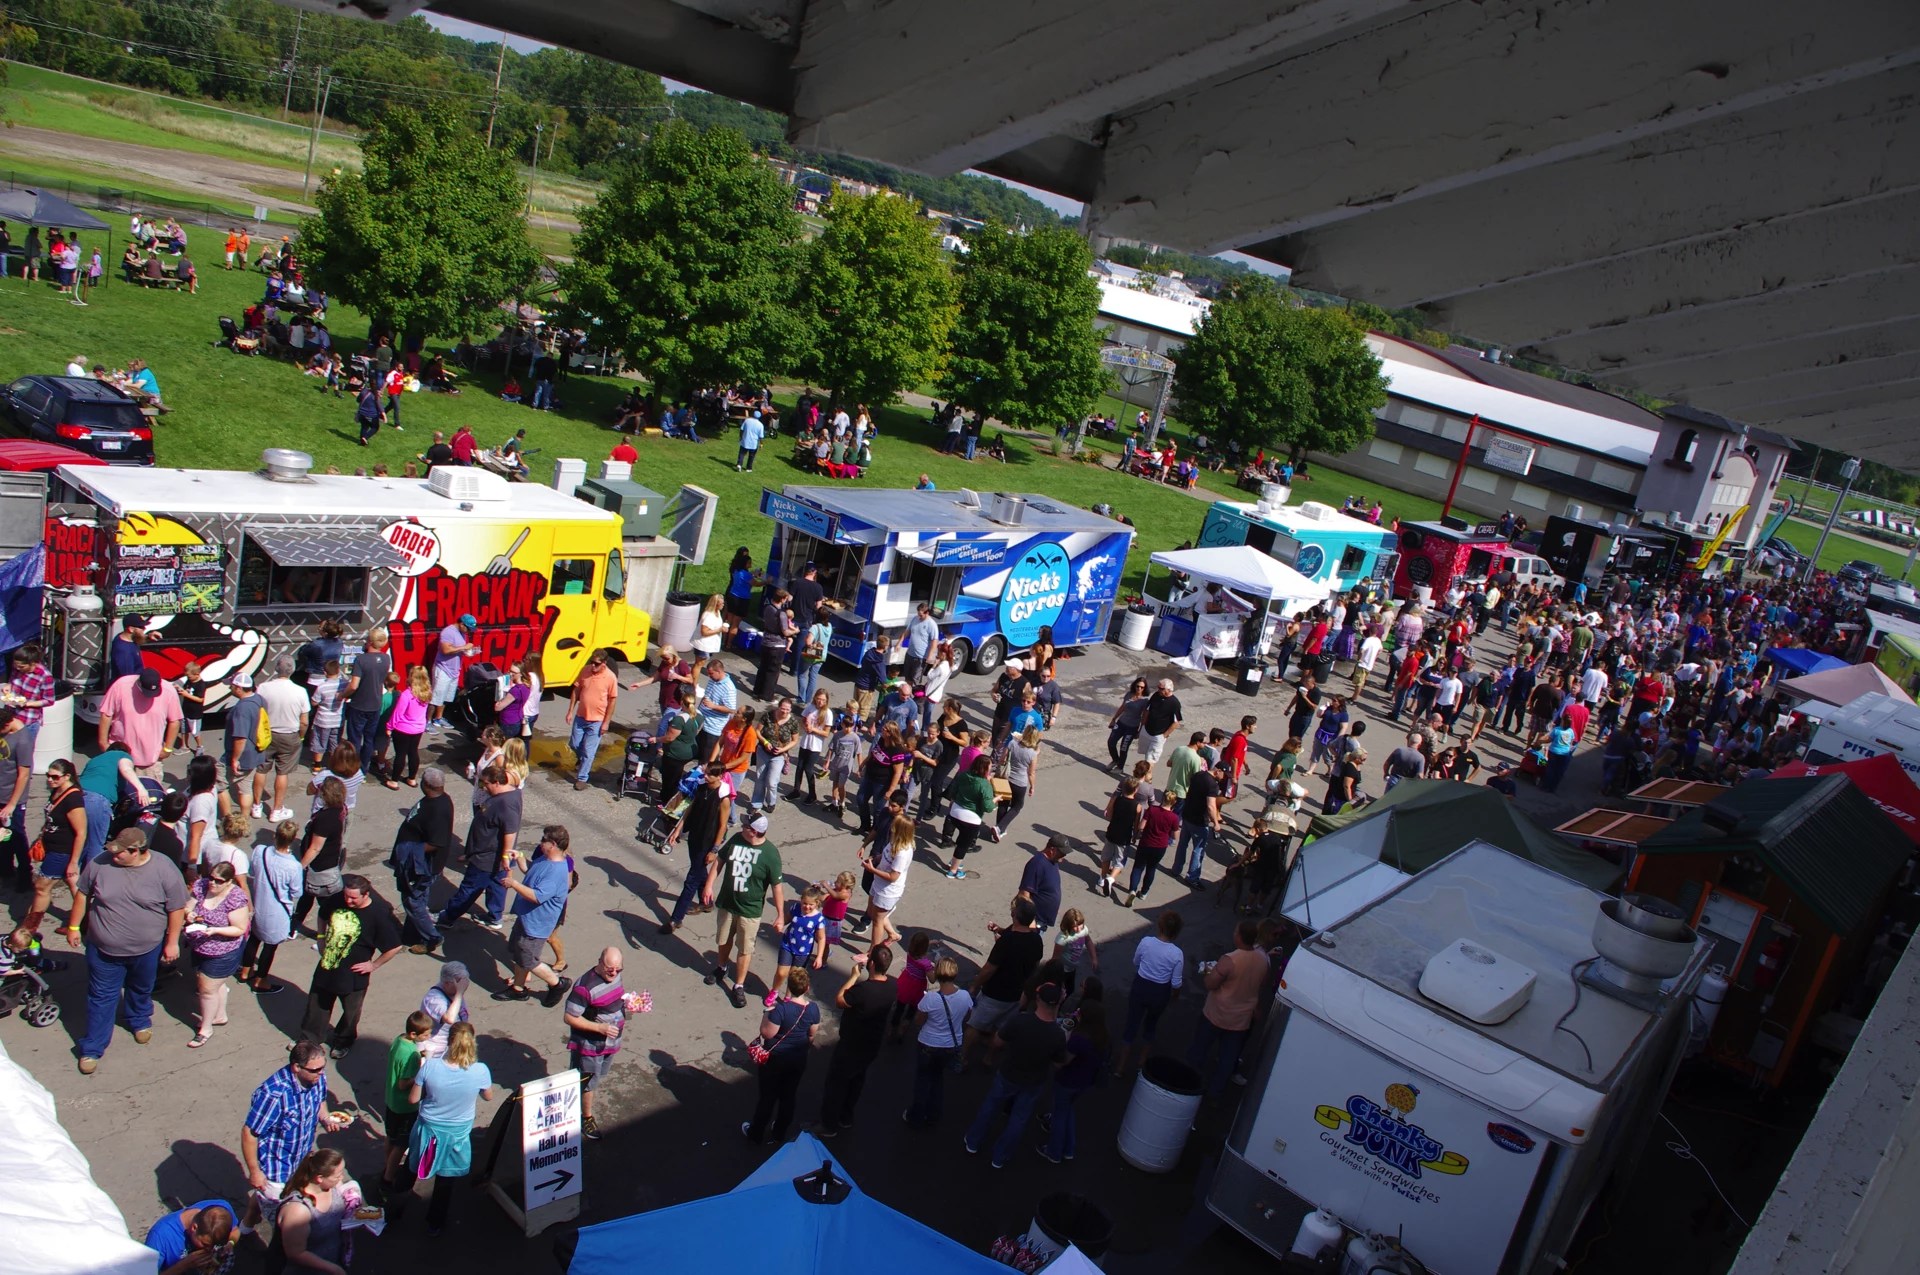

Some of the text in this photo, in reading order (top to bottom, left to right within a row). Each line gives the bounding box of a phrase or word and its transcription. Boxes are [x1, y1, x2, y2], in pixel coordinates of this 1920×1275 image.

[772, 498, 797, 512] Nick's
[774, 510, 799, 521] Gyros
[1477, 525, 1497, 534] CREPES
[389, 525, 436, 558] ORDER
[935, 543, 972, 560] AUTHENTIC
[958, 548, 979, 559] GREEK
[971, 549, 993, 561] STREET
[986, 552, 1004, 562] FOOD
[1005, 571, 1061, 603] Nick's
[418, 567, 544, 628] FRACKIN'
[1009, 592, 1066, 623] Gyros
[1842, 741, 1876, 757] PITA
[729, 845, 762, 864] JUST
[732, 861, 753, 878] DO
[733, 877, 749, 892] IT.
[544, 1092, 562, 1106] IONIA
[545, 1111, 563, 1127] FAIR
[1349, 1097, 1441, 1161] Chunky
[539, 1130, 569, 1152] Hall of
[1348, 1117, 1422, 1178] DUNK
[529, 1146, 578, 1172] Memories
[1319, 1131, 1441, 1204] Gourmet Sandwiches
[1363, 1167, 1382, 1182] with
[1390, 1182, 1422, 1203] Twist
